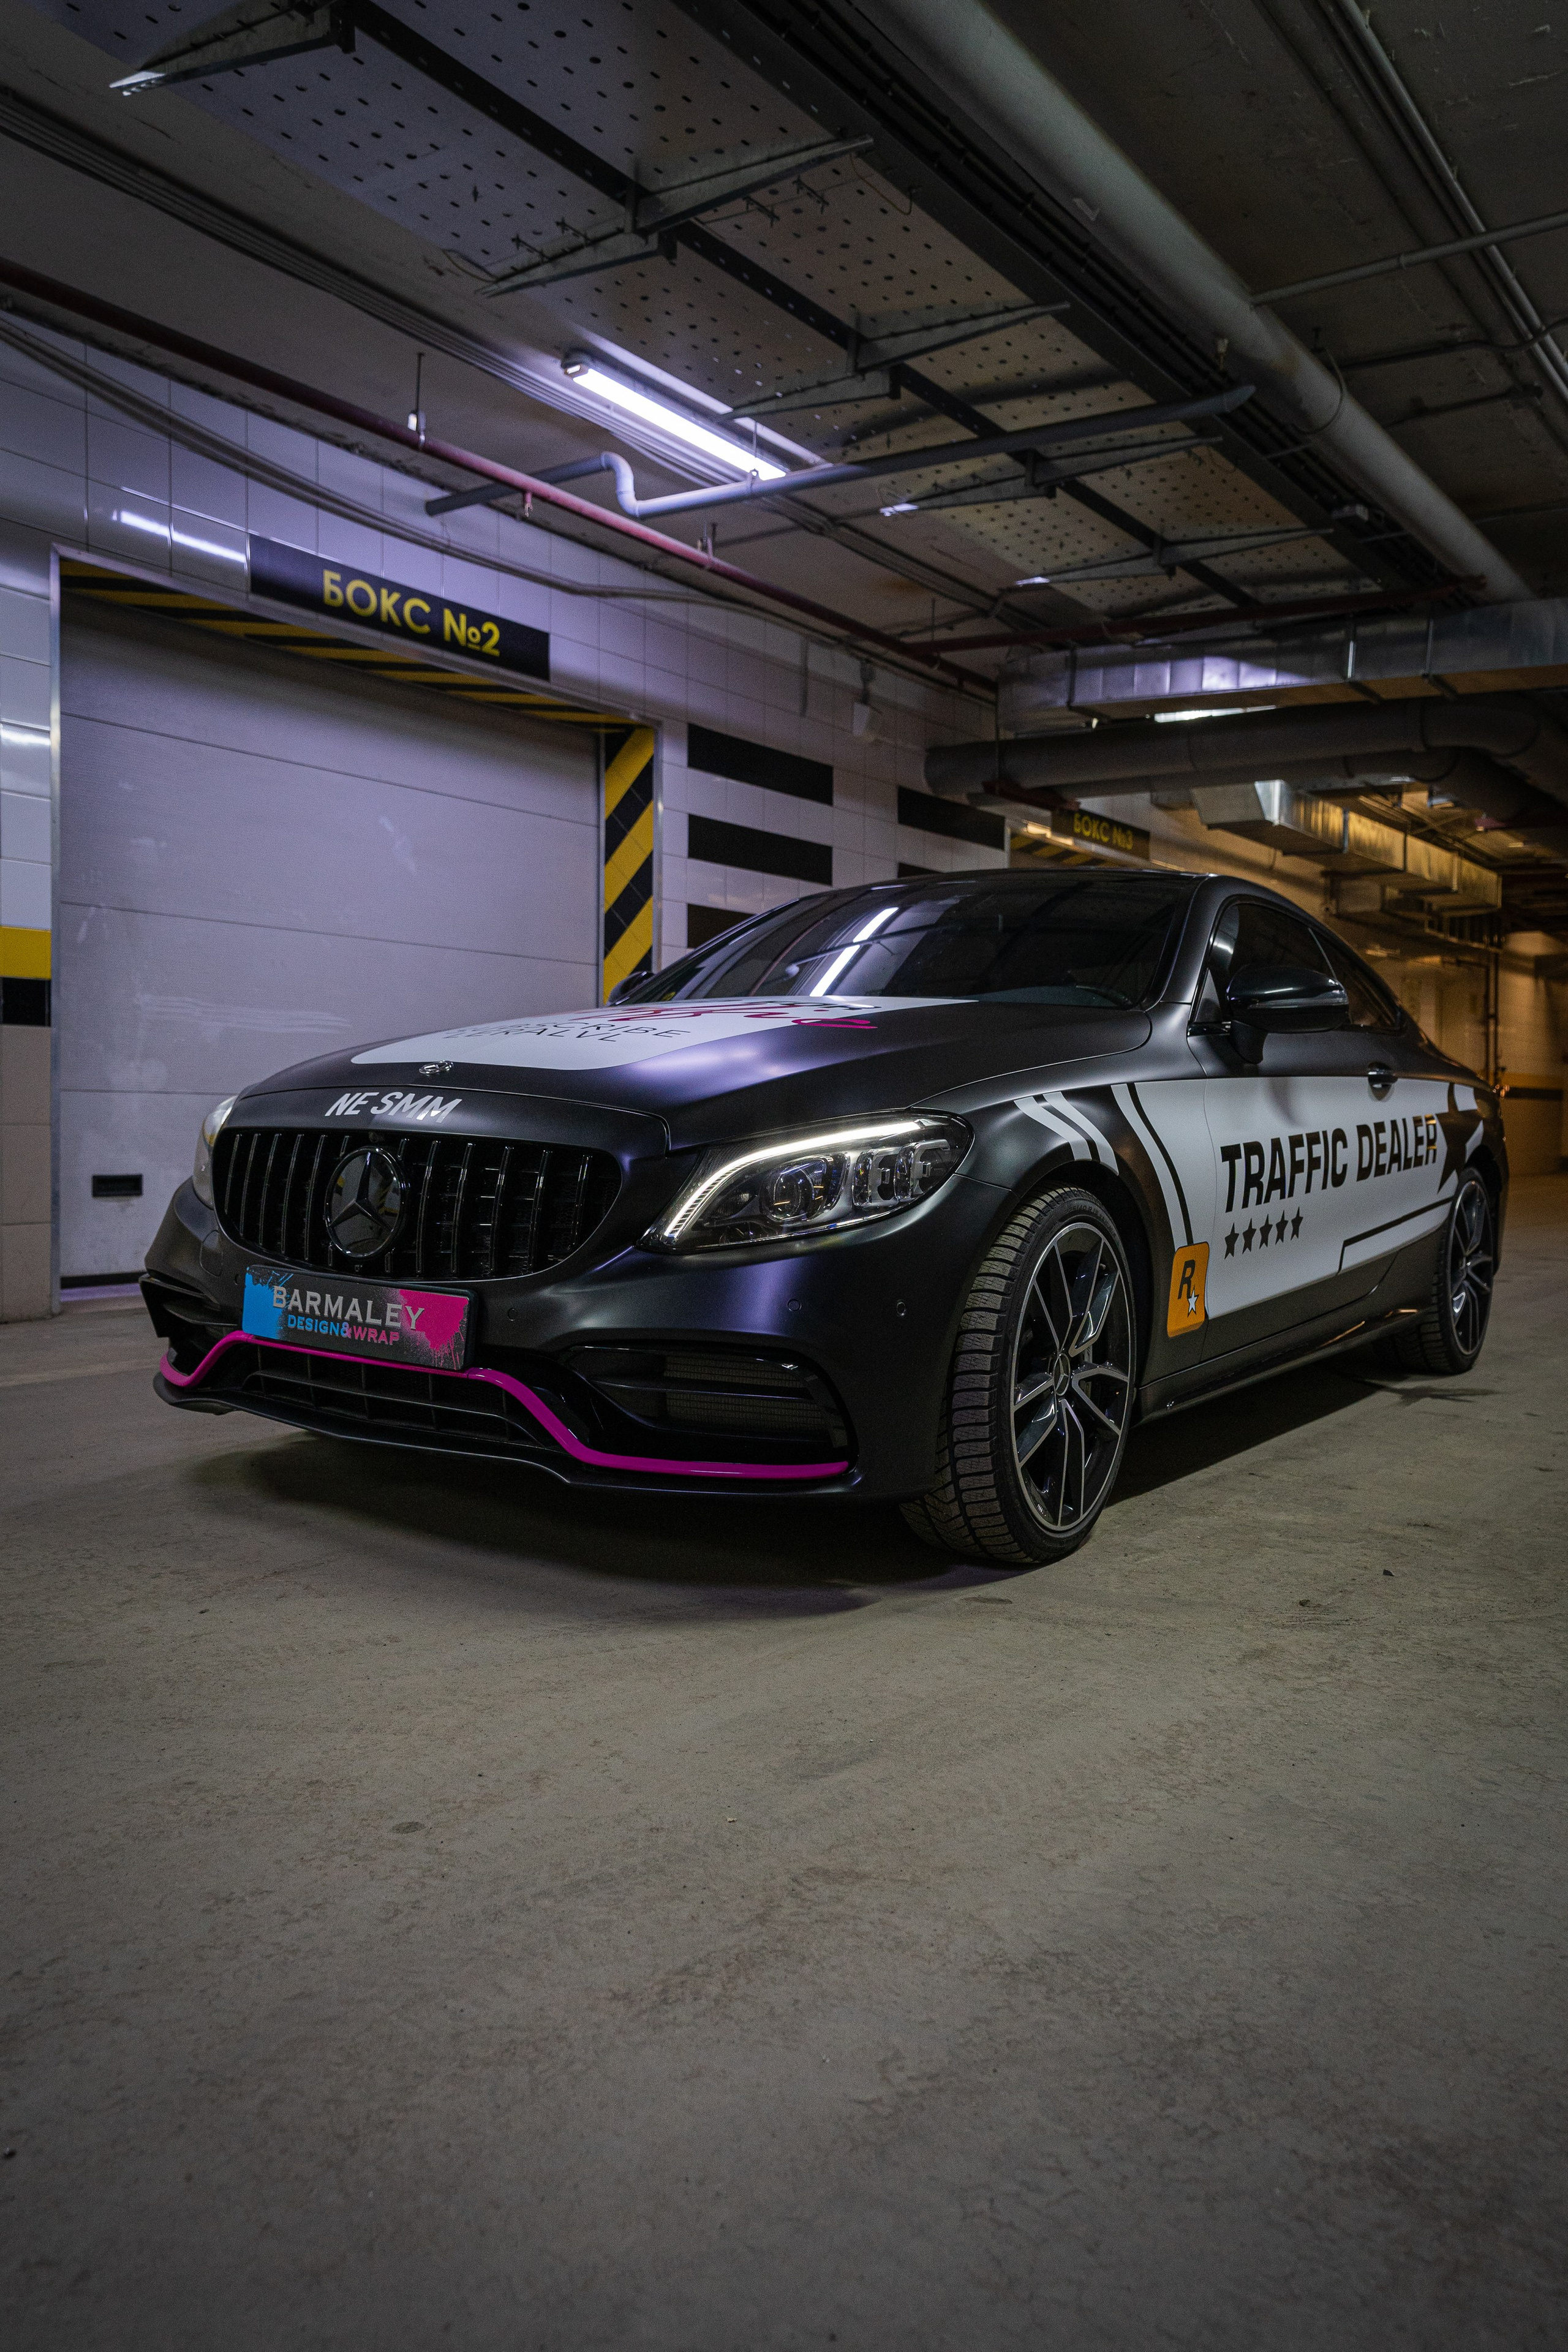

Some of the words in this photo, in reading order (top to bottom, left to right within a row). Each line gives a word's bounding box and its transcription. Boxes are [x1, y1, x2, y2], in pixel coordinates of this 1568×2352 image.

[322, 570, 431, 635] БОКС
[443, 608, 501, 657] №2
[1073, 812, 1110, 843] БОКС
[324, 1092, 380, 1117] NE
[370, 1091, 463, 1123] SMM
[1219, 1128, 1348, 1213] TRAFFIC
[1355, 1114, 1438, 1182] DEALER
[1177, 1259, 1196, 1299] R
[273, 1285, 425, 1330] BARMALEY
[287, 1314, 401, 1346] DESIGN&WRAP
